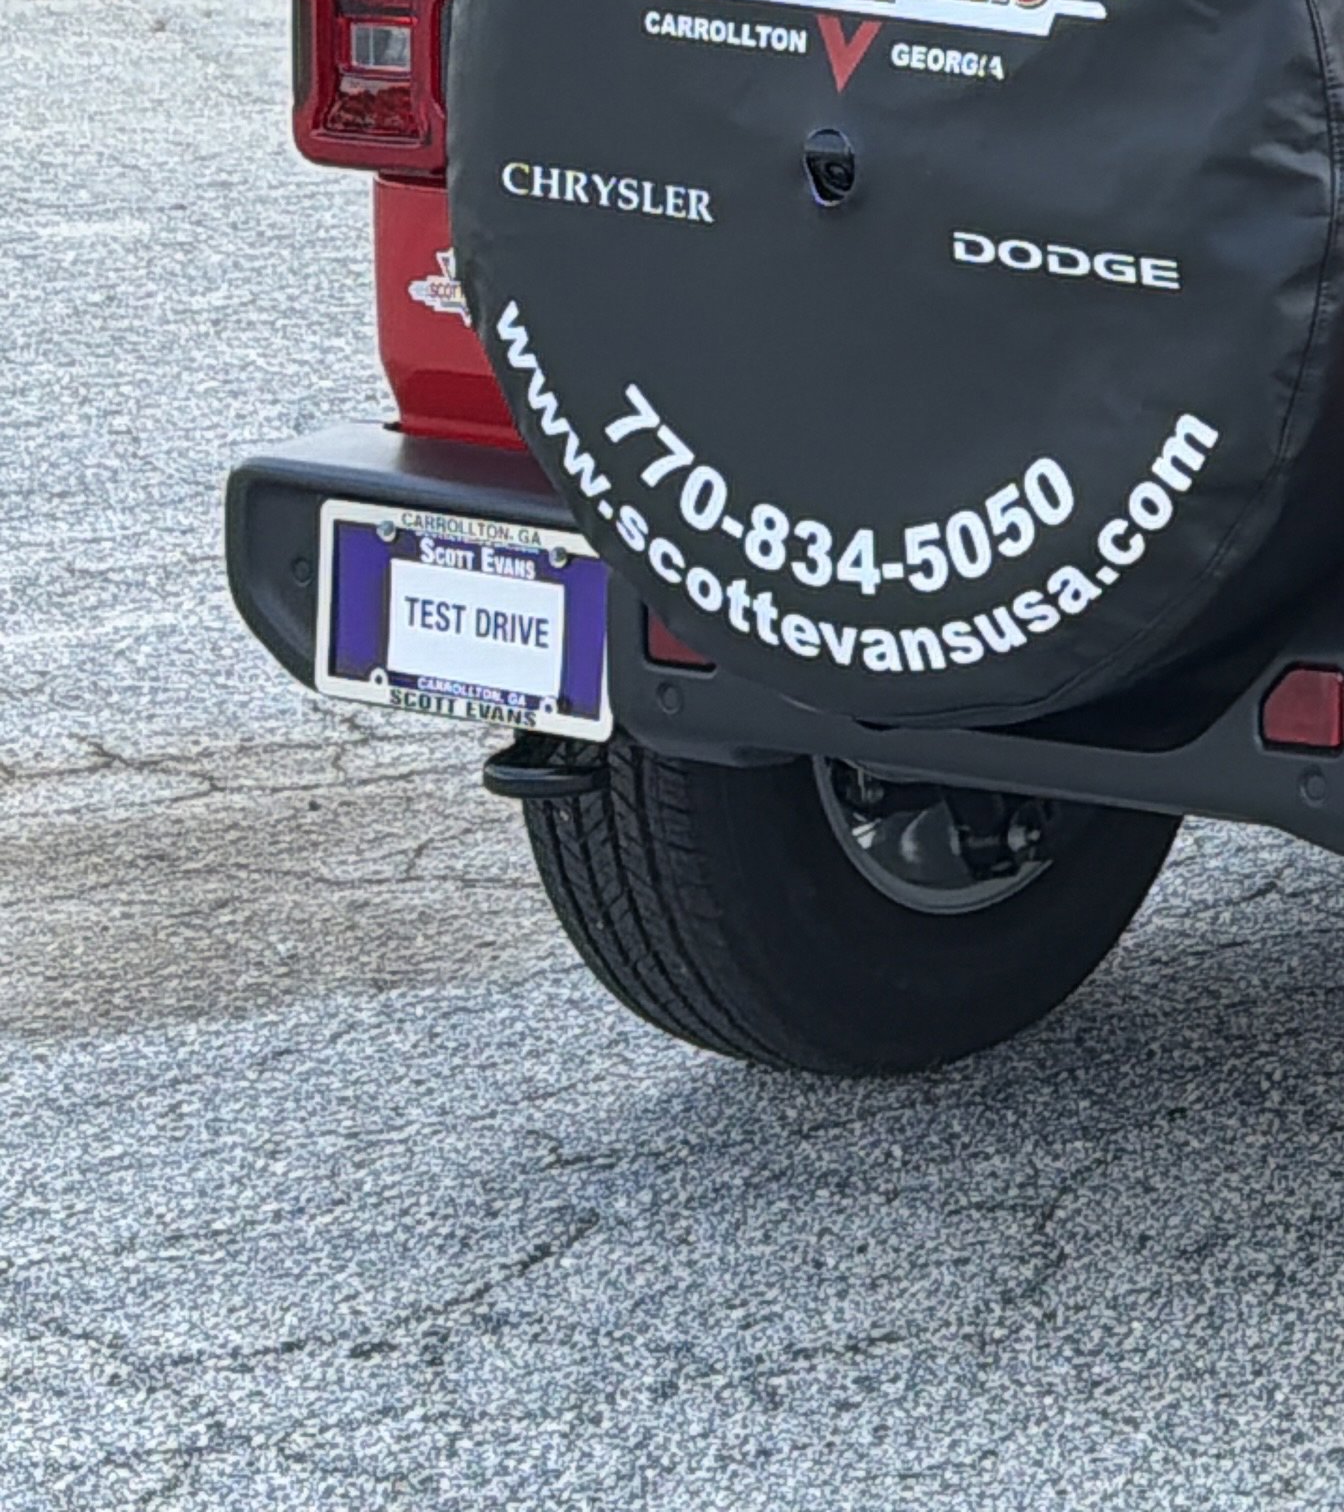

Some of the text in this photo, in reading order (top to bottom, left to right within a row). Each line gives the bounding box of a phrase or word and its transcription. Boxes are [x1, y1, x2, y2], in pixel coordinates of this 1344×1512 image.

[644, 11, 807, 54] CARROLLTON
[891, 42, 1004, 81] GEORGIA
[502, 162, 714, 223] CHRYSLER
[953, 231, 1180, 289] DODGE
[496, 300, 1219, 672] www.scottevansusa.com
[605, 384, 1074, 595] 770-834-5050
[518, 529, 541, 546] GA
[404, 596, 549, 649] TEST DRIVE
[389, 688, 537, 727] SCOTT EVANS
[507, 692, 527, 707] GA
